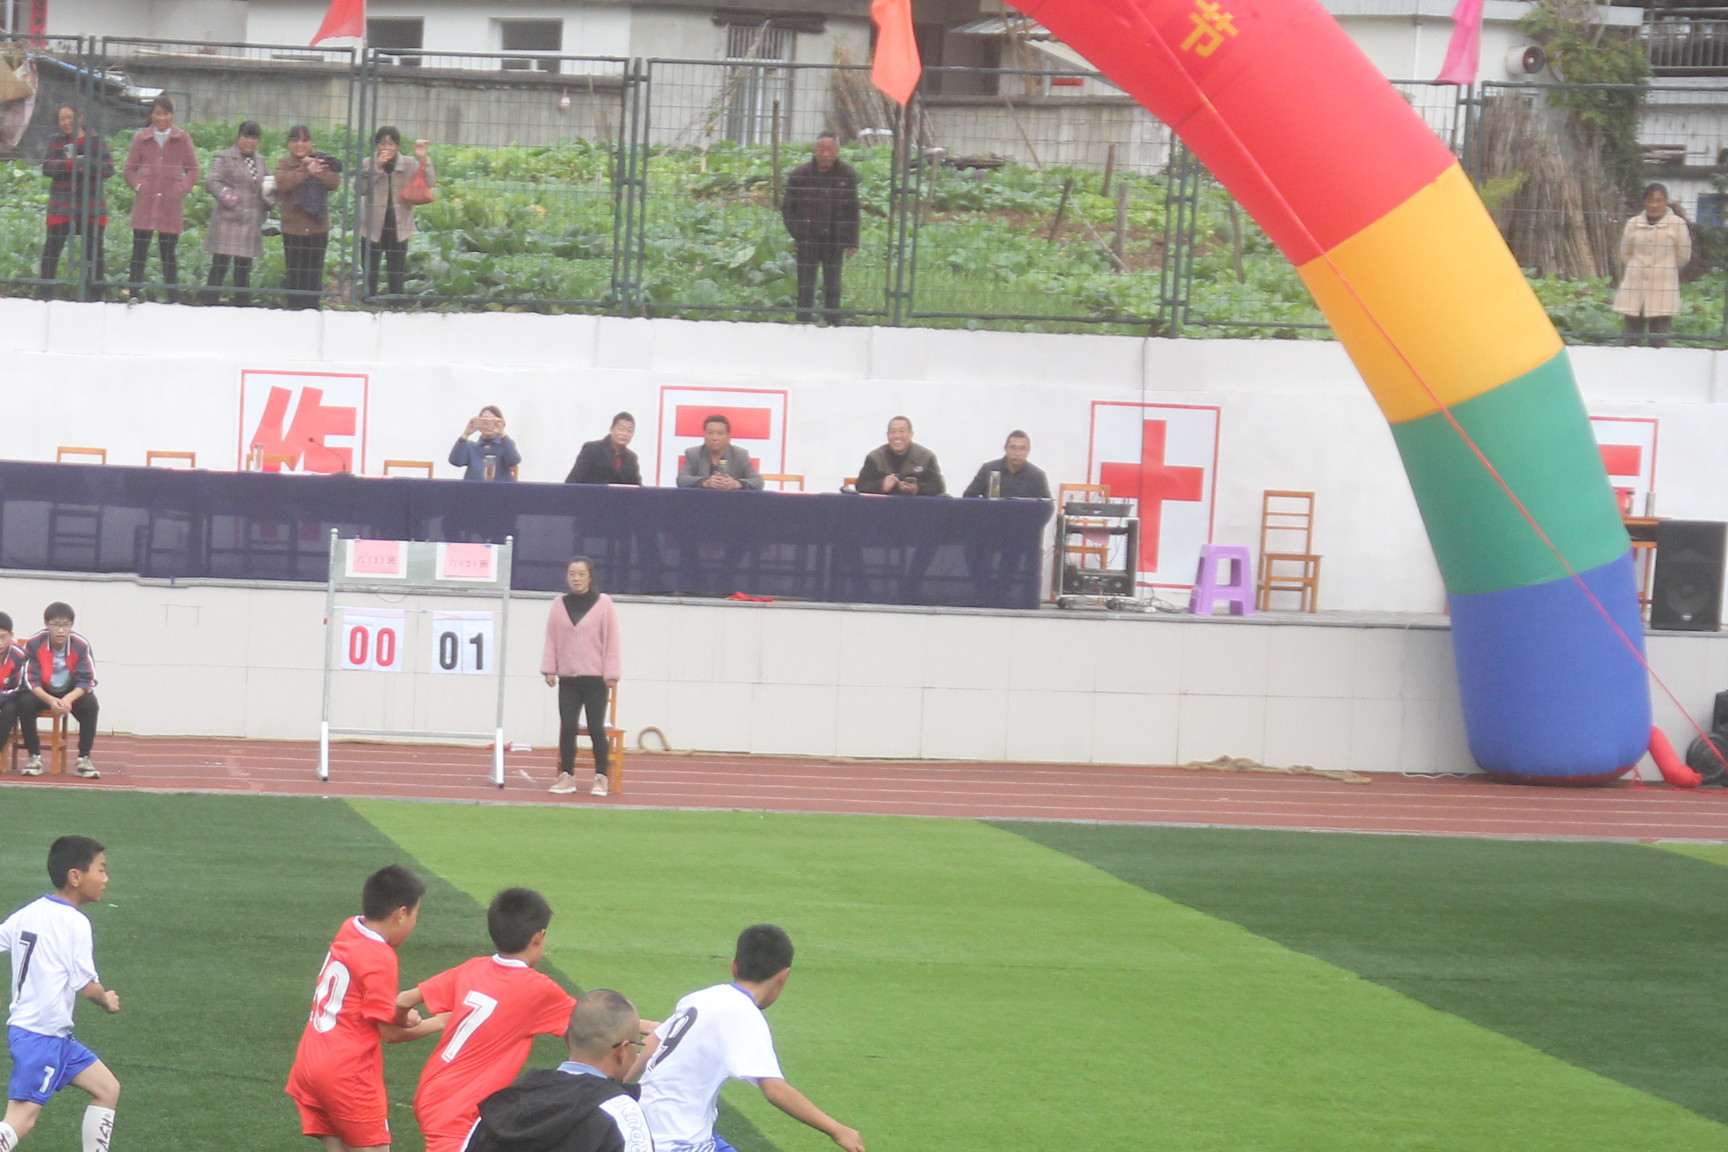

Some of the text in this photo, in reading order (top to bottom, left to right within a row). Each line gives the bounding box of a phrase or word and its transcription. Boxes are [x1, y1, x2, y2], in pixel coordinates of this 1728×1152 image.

[349, 625, 396, 667] 00
[439, 631, 484, 670] 01
[16, 930, 38, 1004] 7
[441, 990, 498, 1063] 7
[648, 1006, 698, 1072] 9
[39, 1065, 55, 1094] 7
